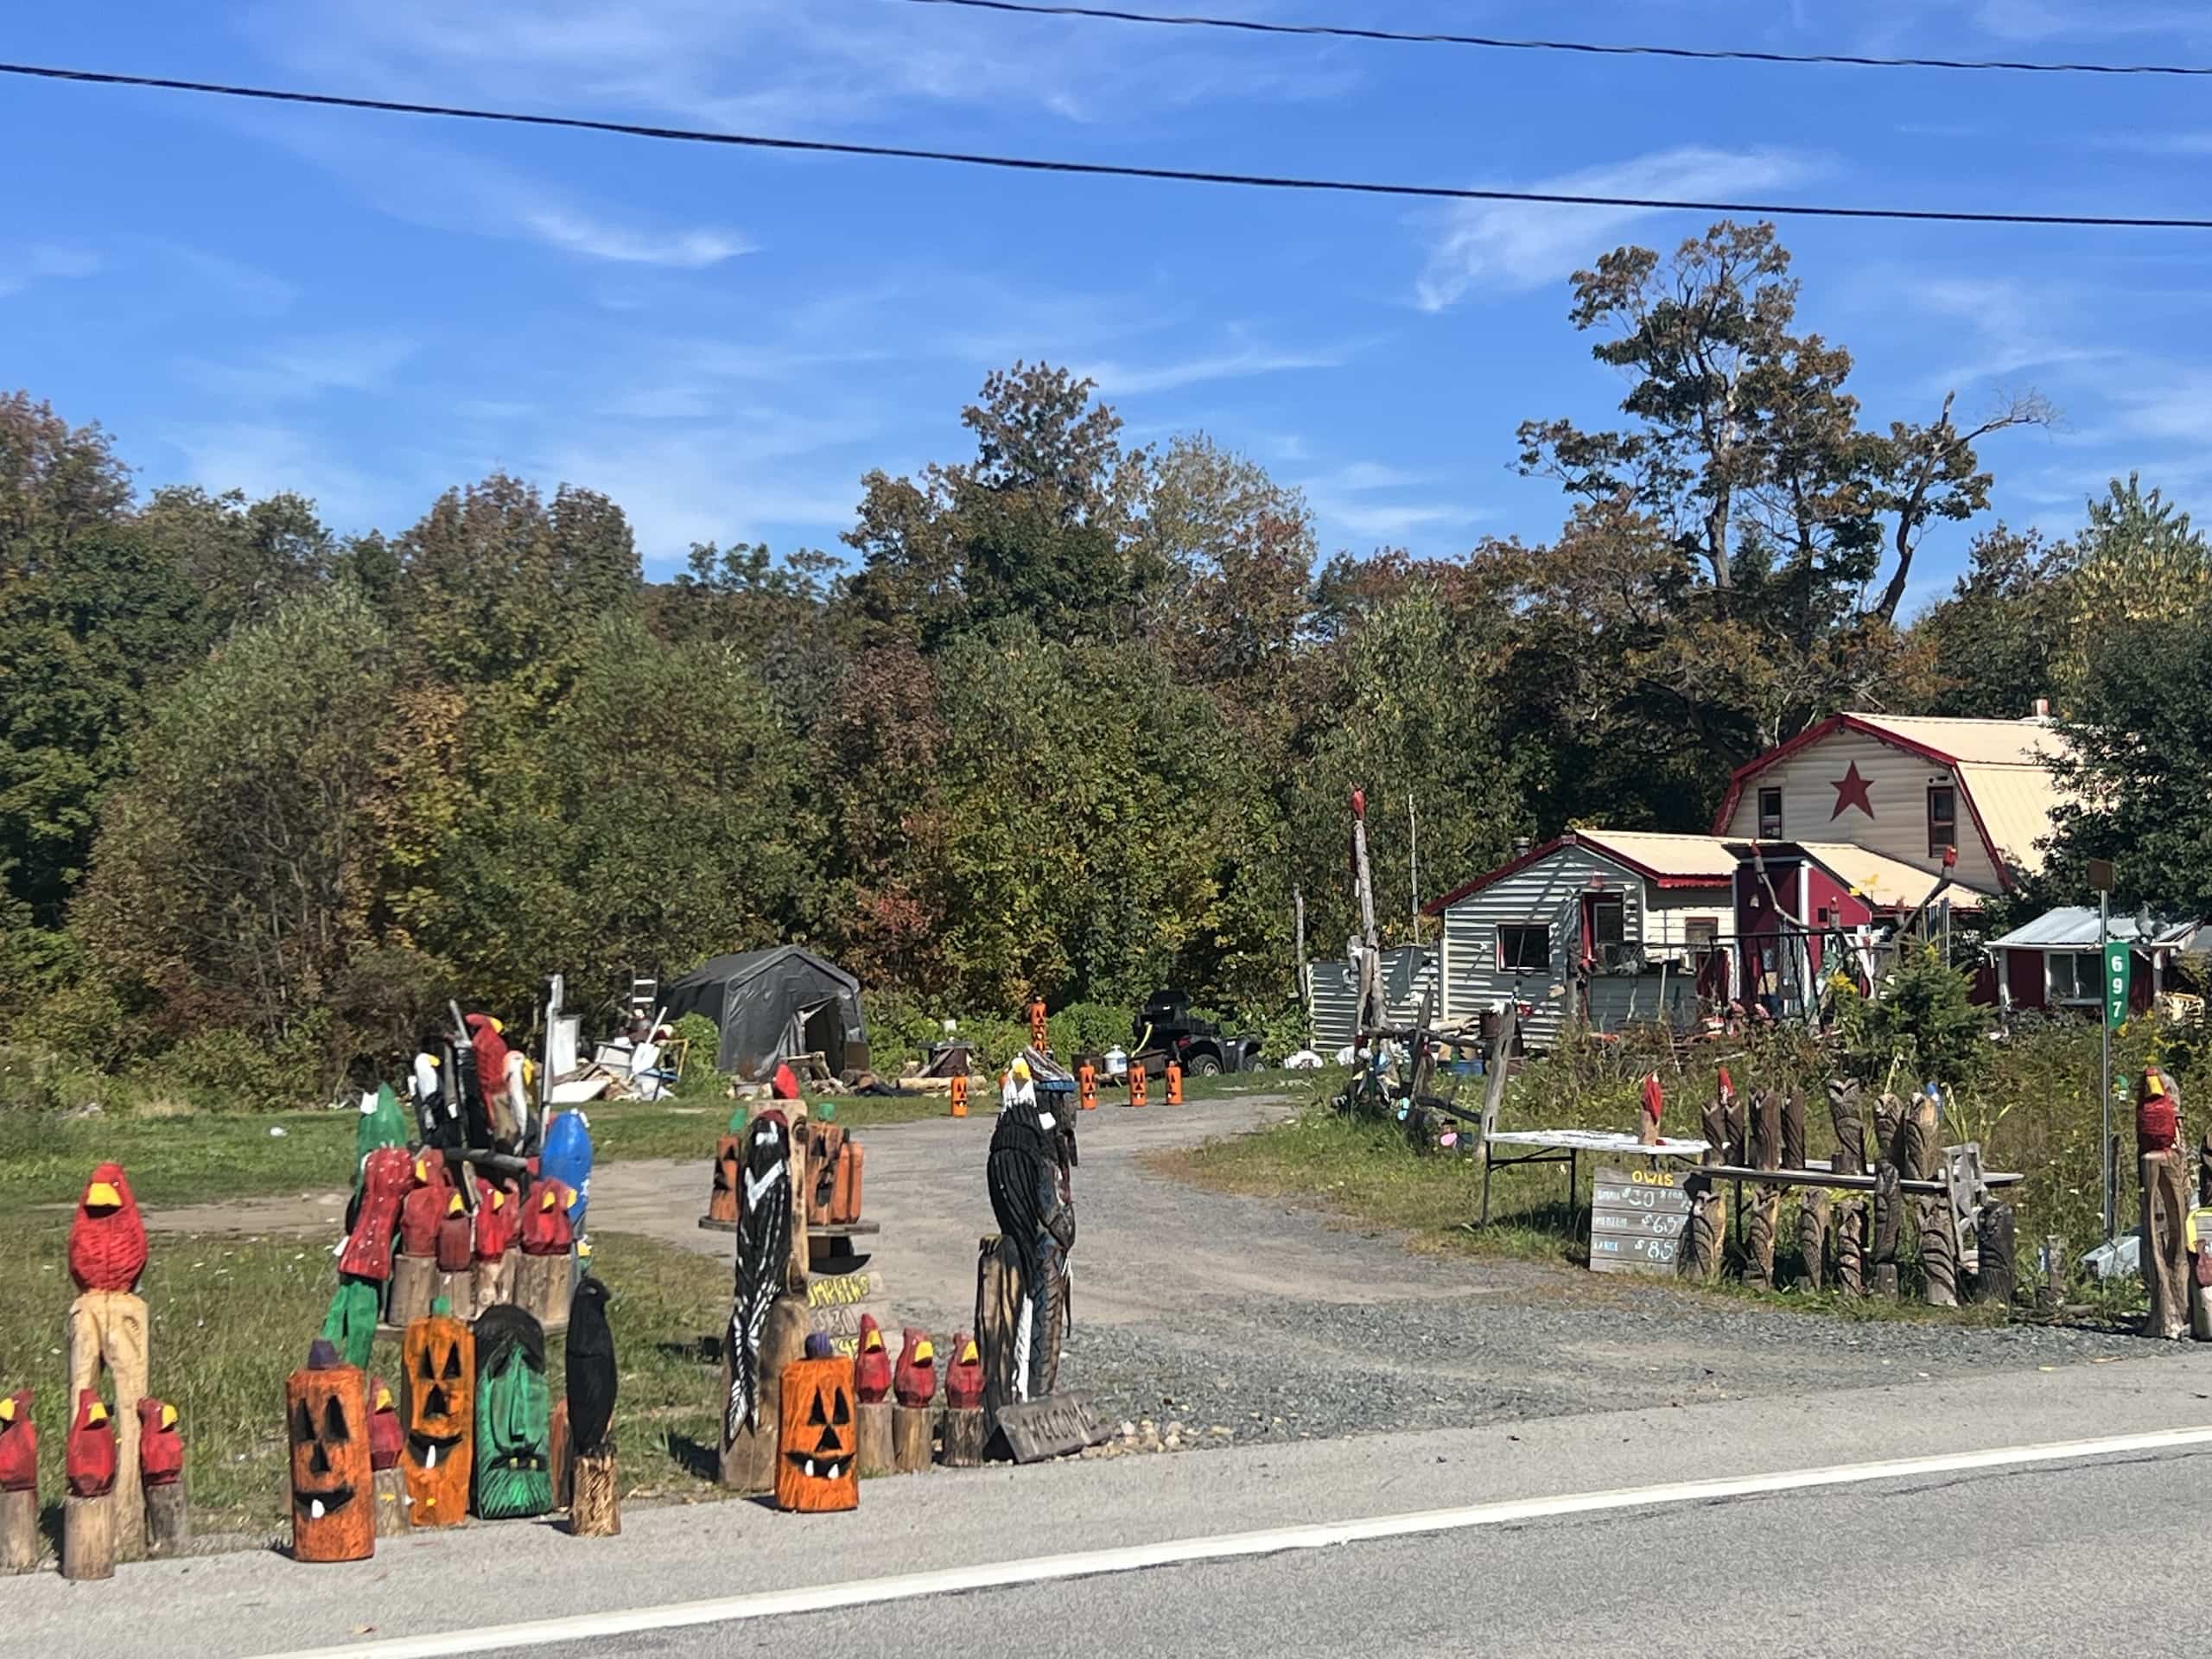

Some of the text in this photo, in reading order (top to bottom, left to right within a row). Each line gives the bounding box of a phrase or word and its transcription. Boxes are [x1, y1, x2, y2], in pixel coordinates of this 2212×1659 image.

[2111, 955, 2123, 1018] 697
[1631, 1170, 1674, 1186] OWLS
[1634, 1239, 1674, 1260] $85
[807, 1274, 868, 1307] UMPKINS
[1021, 1401, 1097, 1440] WELCOME
